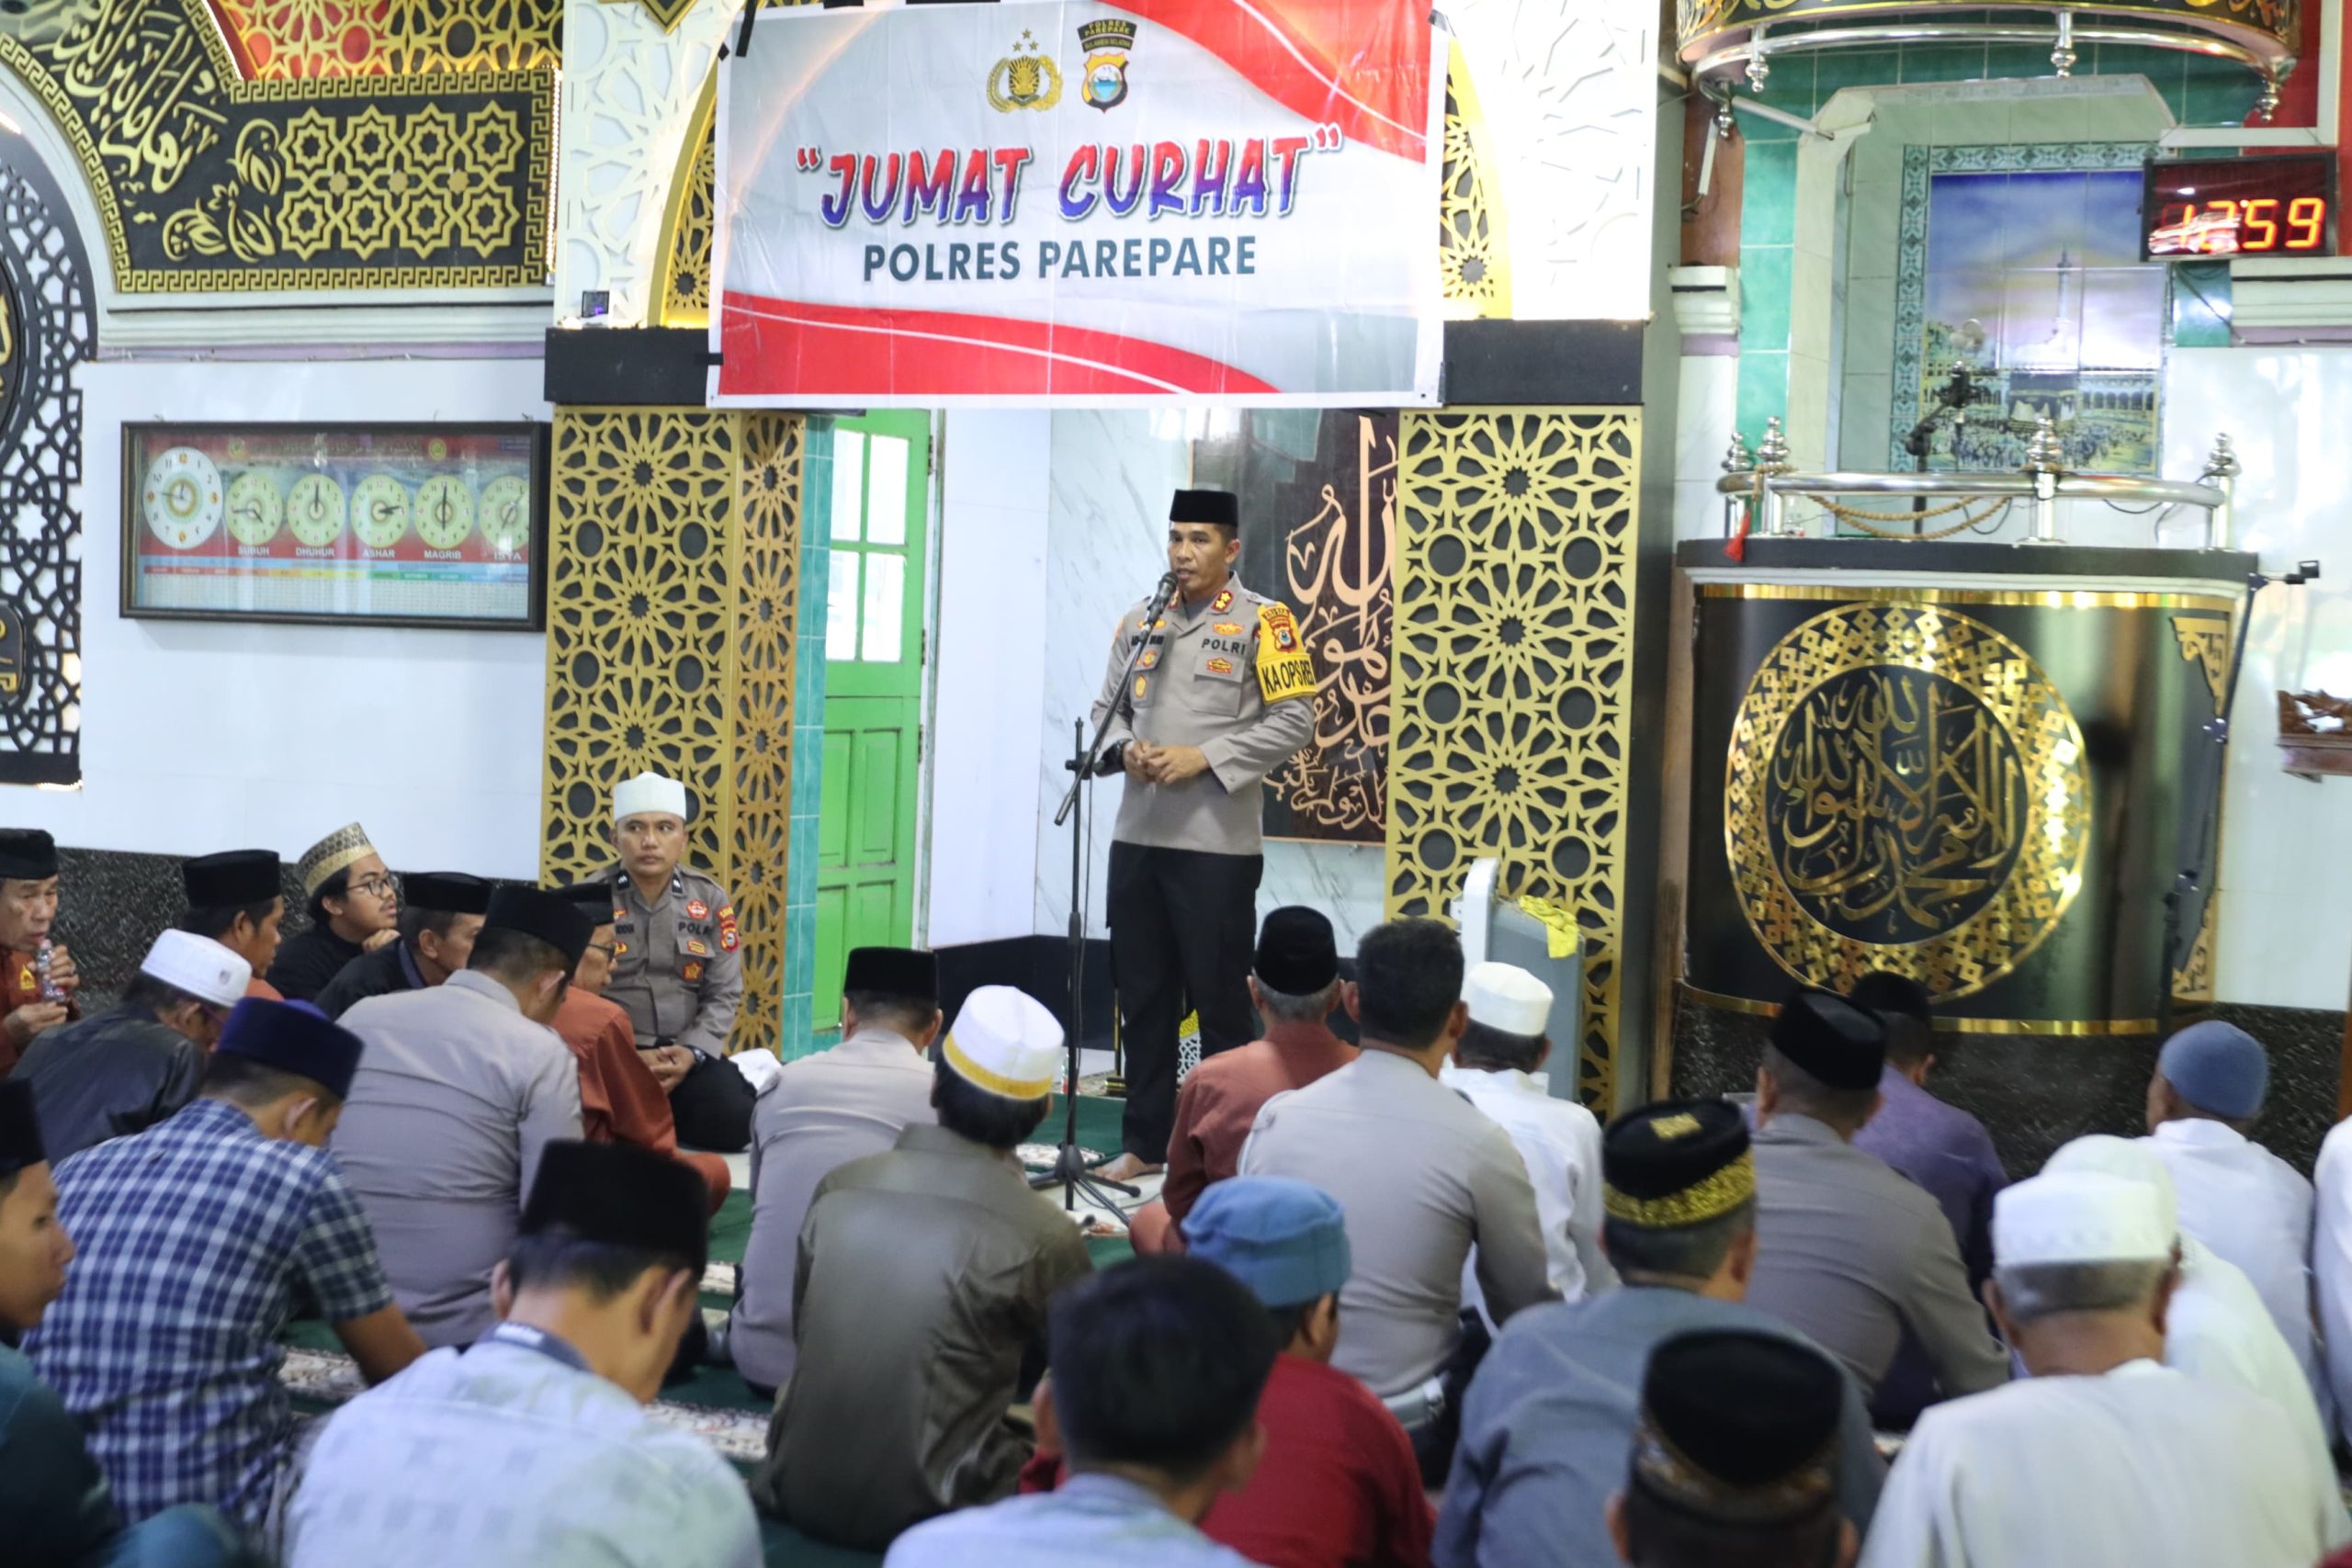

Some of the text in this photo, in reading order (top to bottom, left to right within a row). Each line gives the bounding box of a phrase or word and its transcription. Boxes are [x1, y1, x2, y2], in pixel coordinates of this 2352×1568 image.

[863, 234, 1257, 282] POLRES PAREPARE
[238, 546, 270, 556] SUBUH
[295, 547, 336, 558] DHUHUR
[362, 548, 396, 558] ASHAR
[424, 549, 462, 559] MAGRIB
[1201, 637, 1247, 656] POLRI
